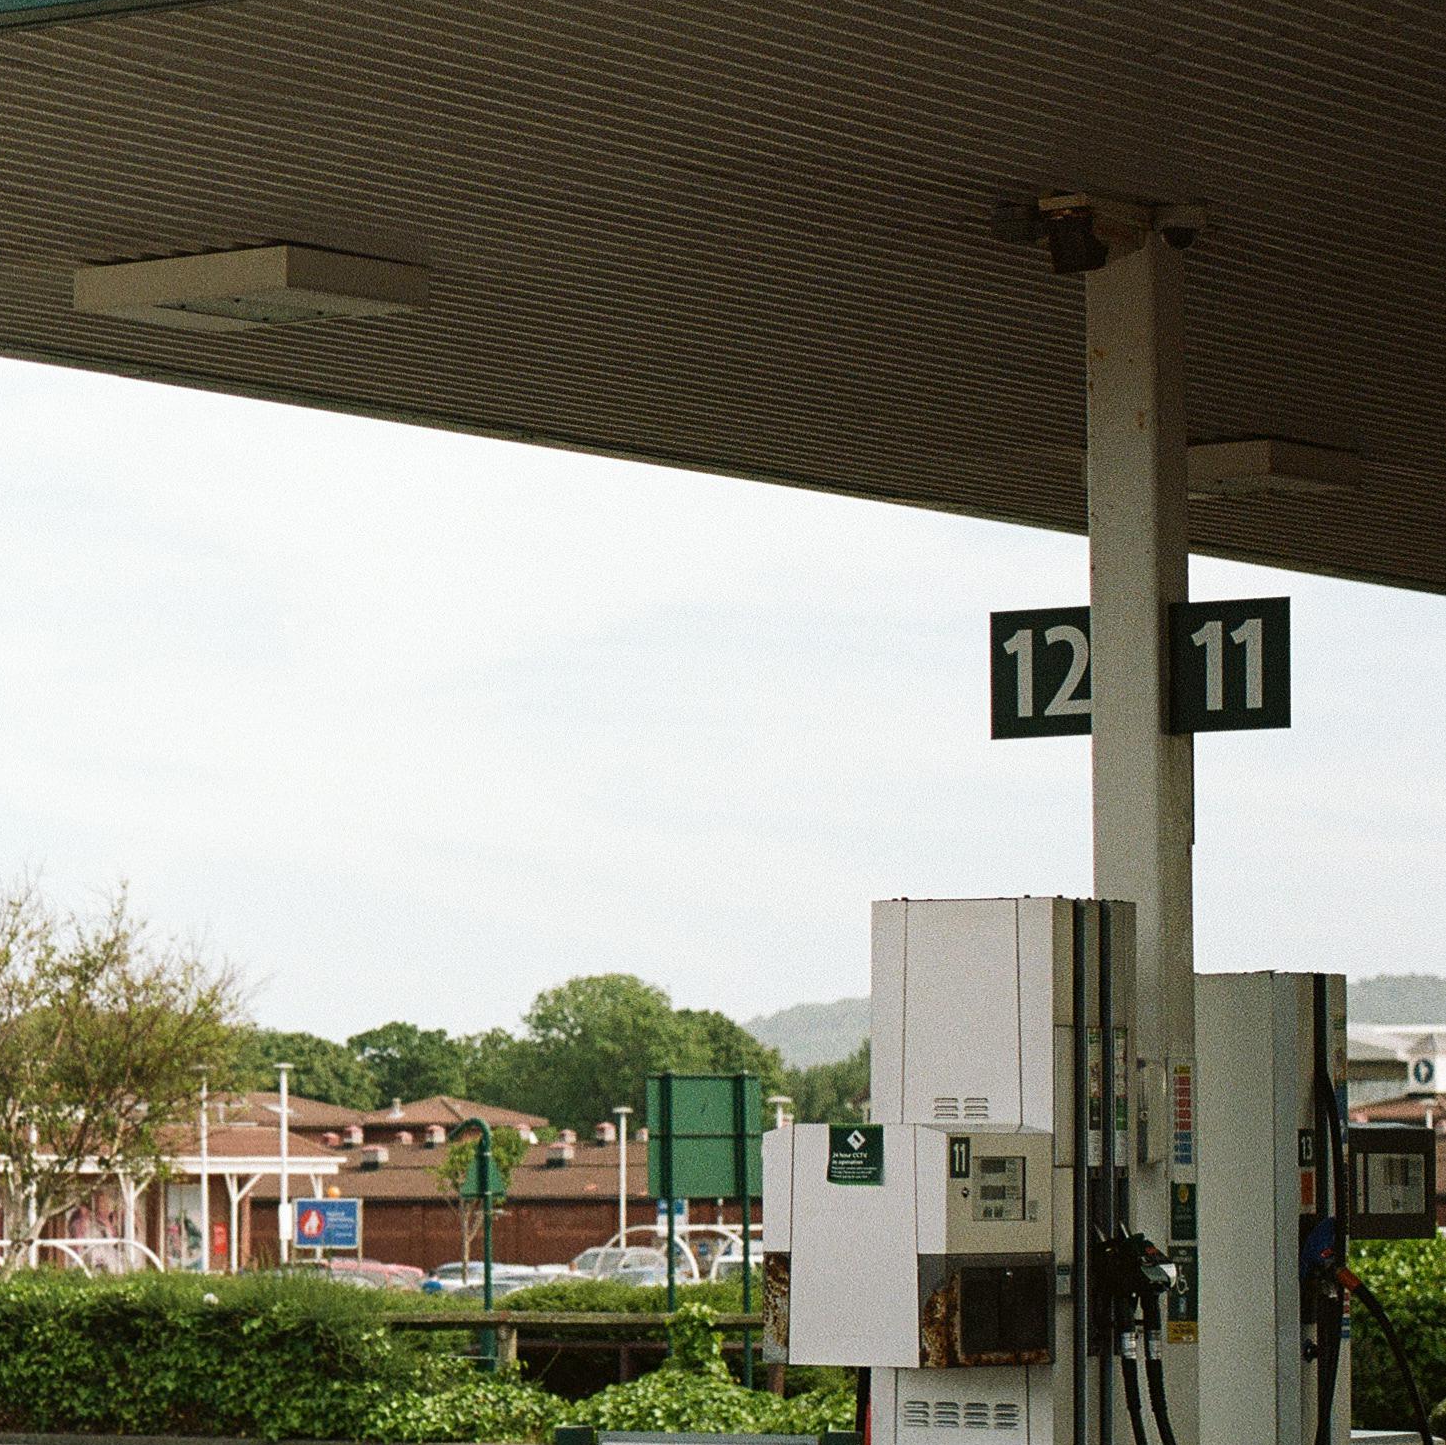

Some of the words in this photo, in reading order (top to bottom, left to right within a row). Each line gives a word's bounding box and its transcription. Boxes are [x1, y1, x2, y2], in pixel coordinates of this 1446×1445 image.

[1003, 624, 1092, 718] 12
[1191, 617, 1263, 712] 11
[953, 1143, 966, 1172] 11
